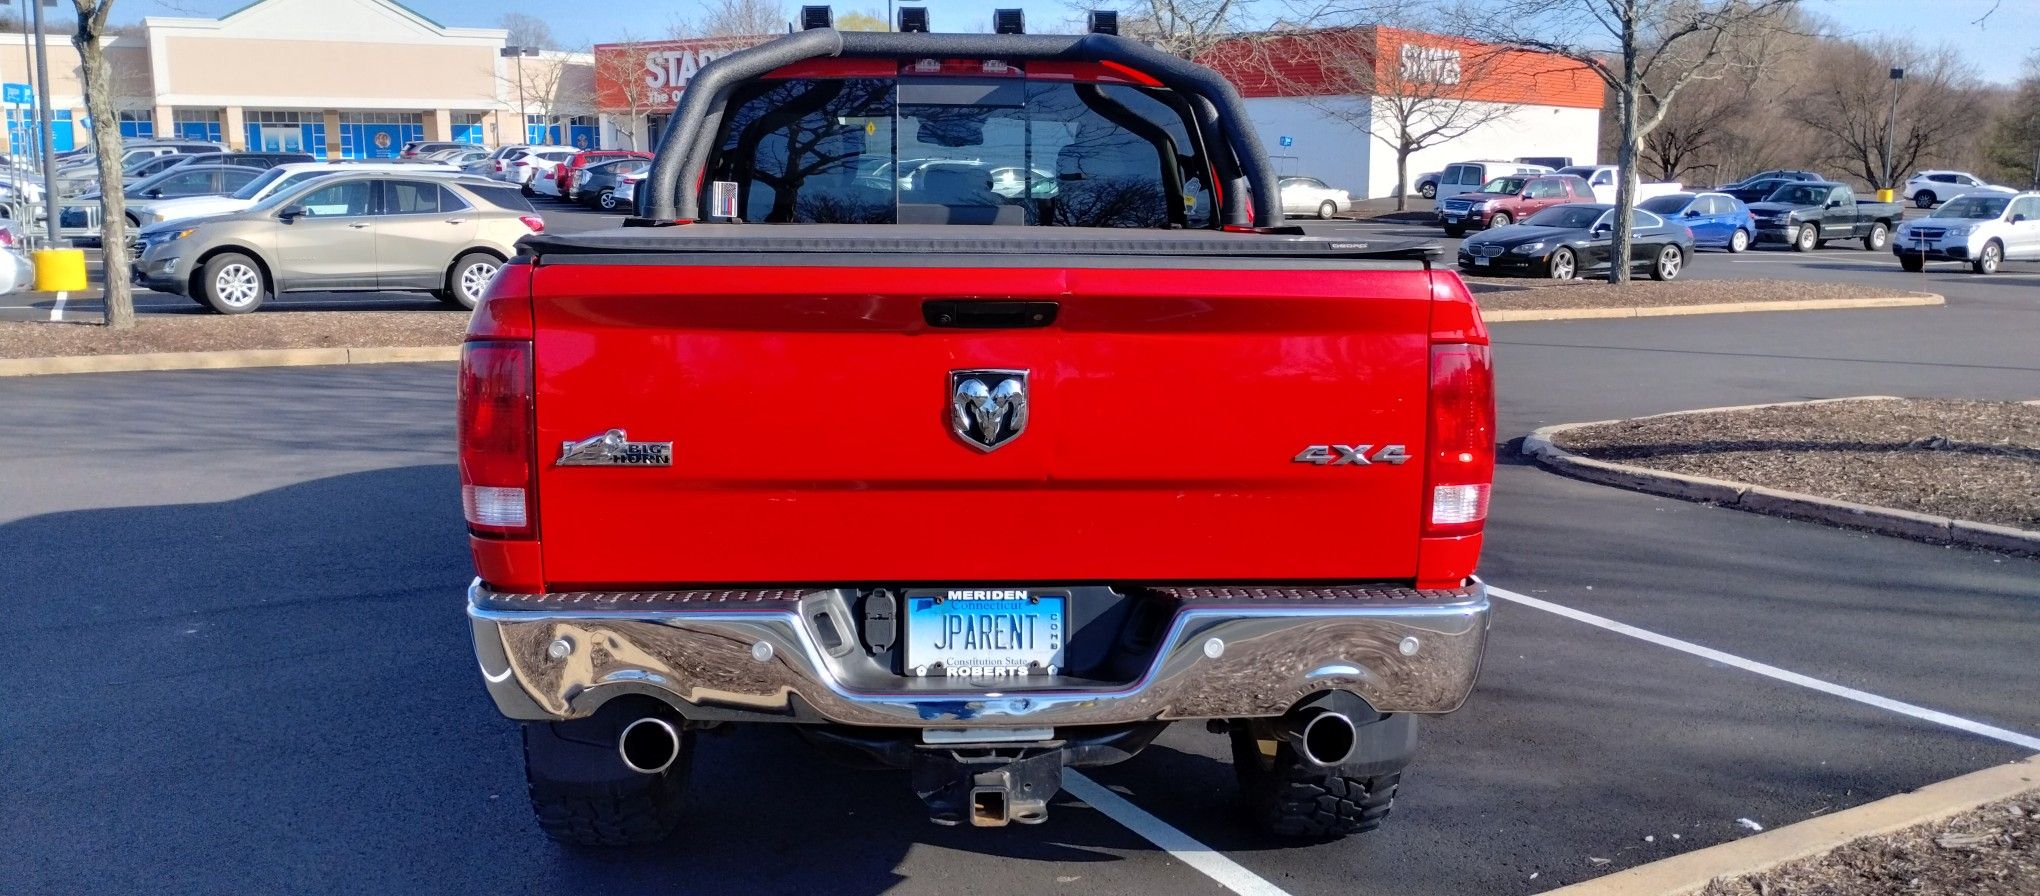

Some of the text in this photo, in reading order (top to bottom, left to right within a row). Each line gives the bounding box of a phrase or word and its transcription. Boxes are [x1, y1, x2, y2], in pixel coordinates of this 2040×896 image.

[628, 444, 662, 454] BIG
[612, 454, 669, 464] HORN
[947, 590, 1028, 600] MERIDEN
[951, 600, 1022, 610] Connecticut
[934, 614, 1038, 650] JPARENT
[946, 656, 1028, 666] Constitution State
[946, 666, 1029, 677] ROBERTS
